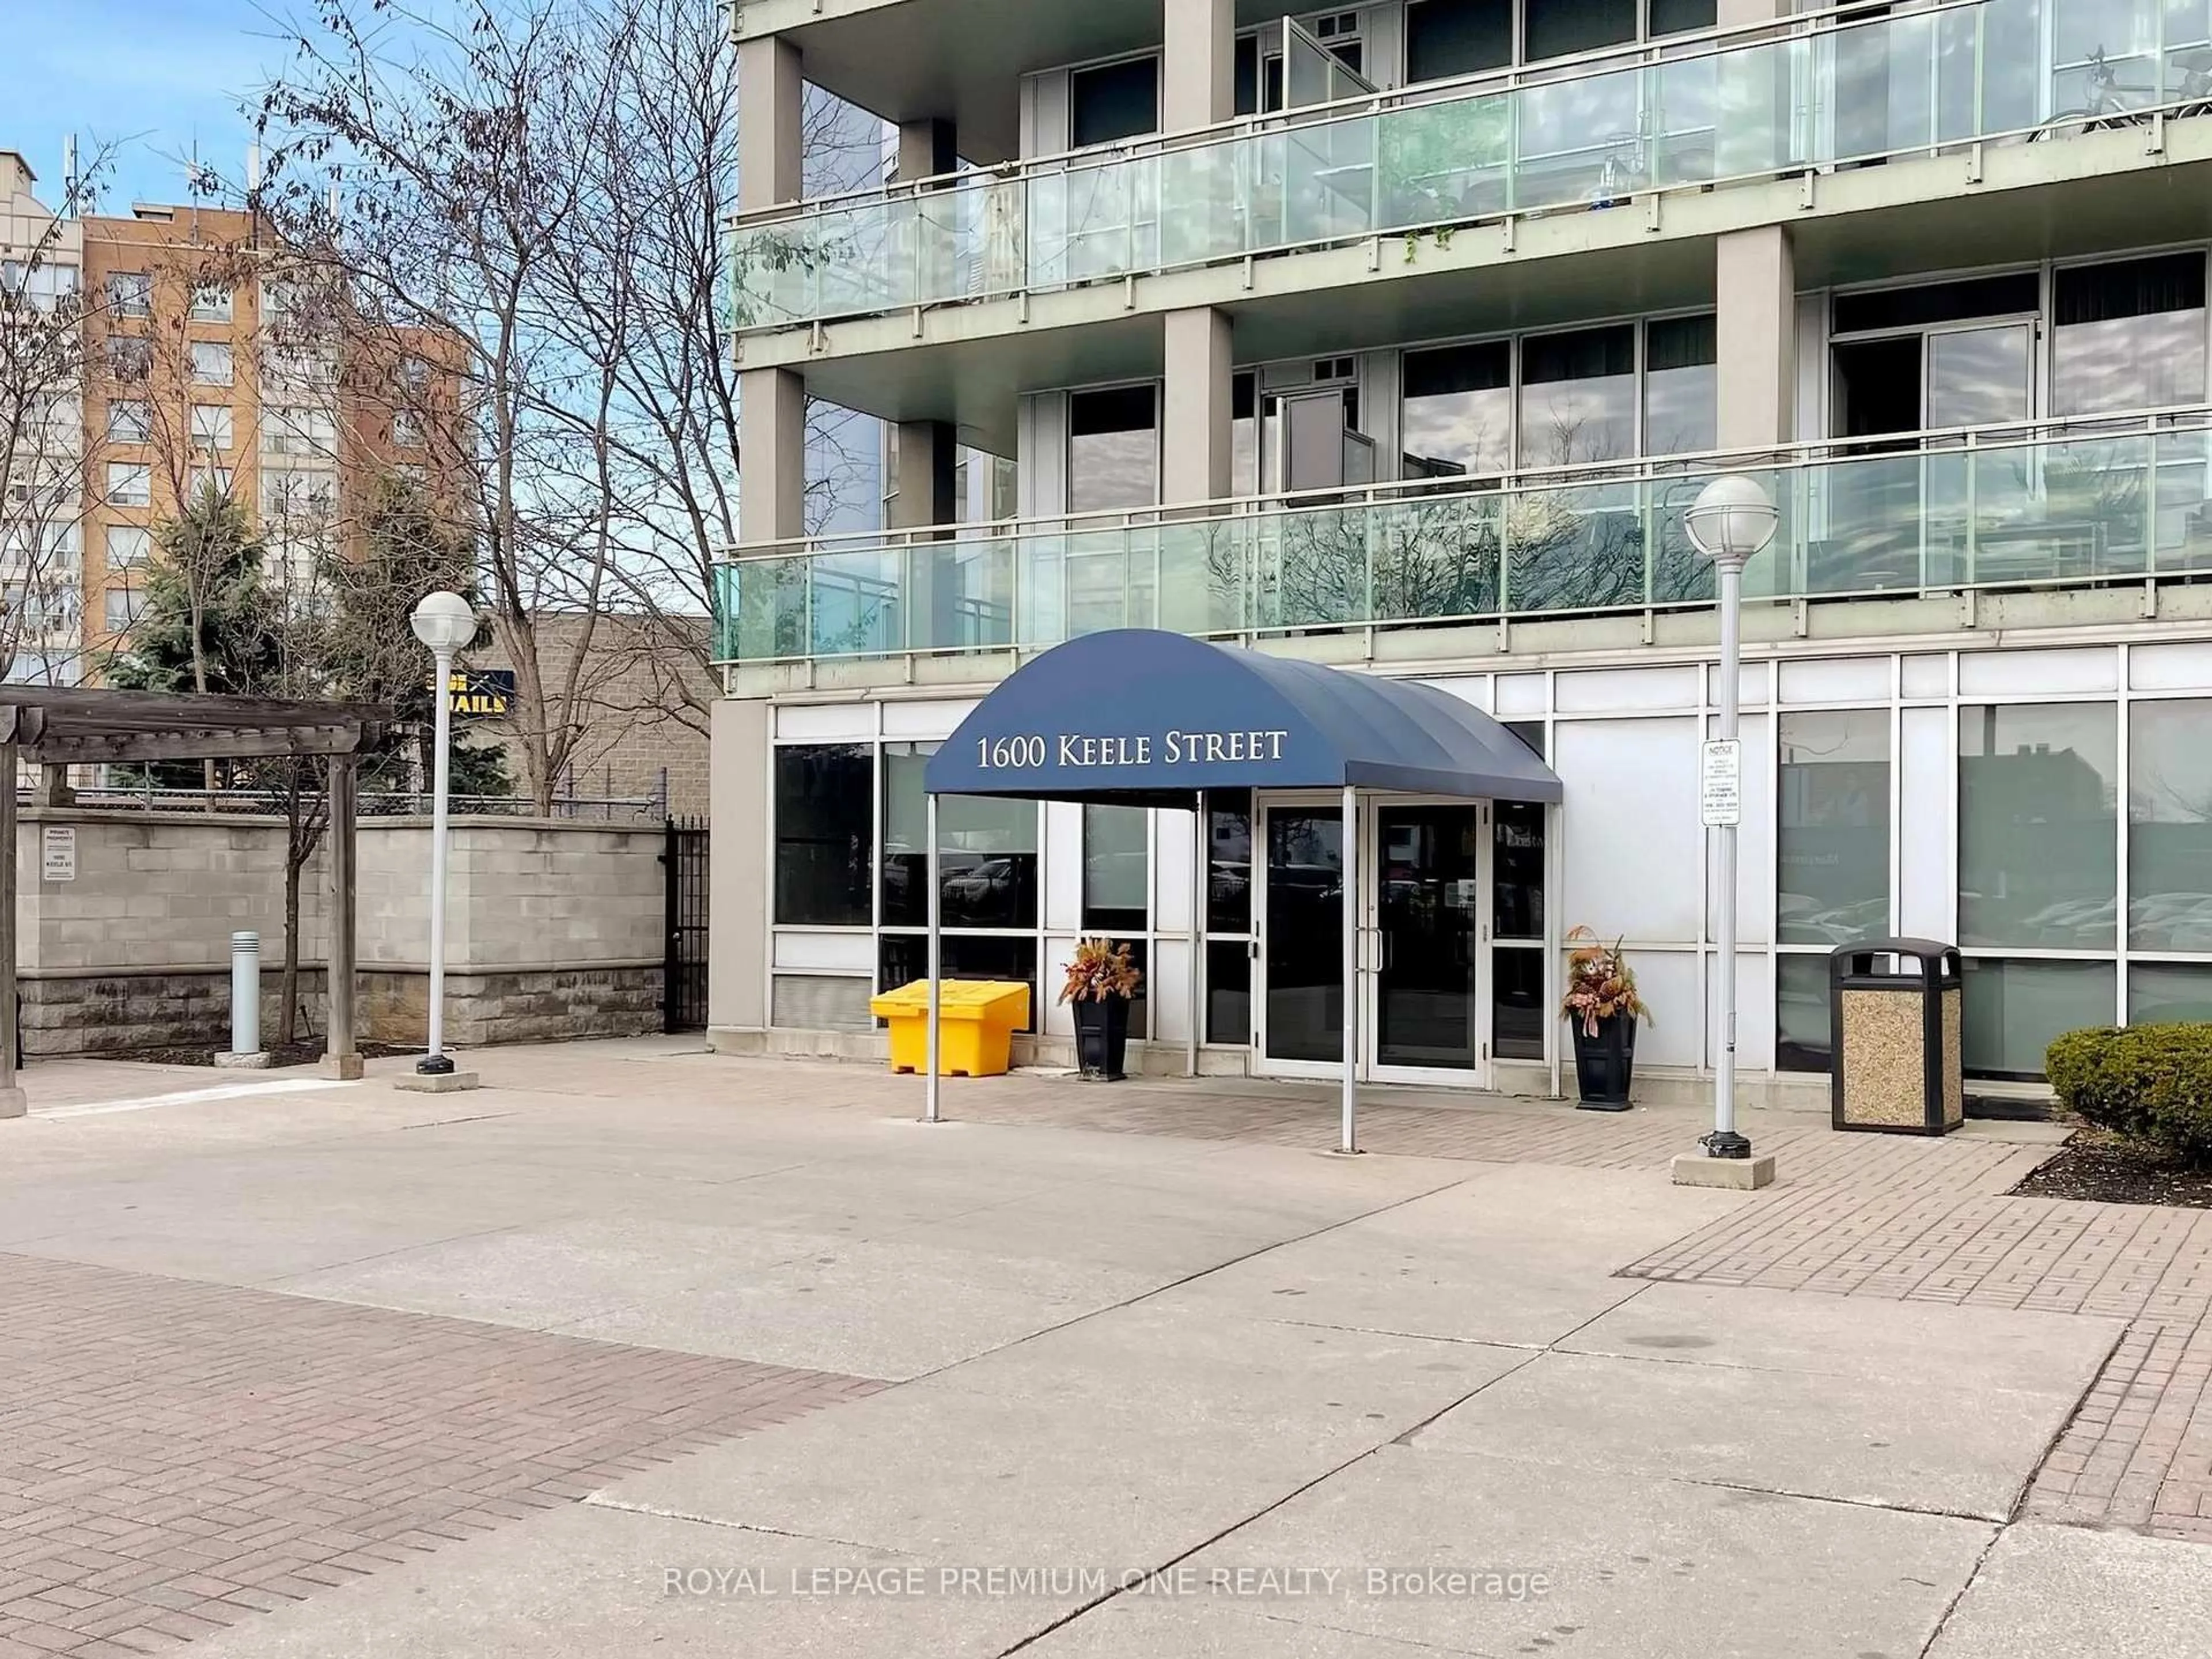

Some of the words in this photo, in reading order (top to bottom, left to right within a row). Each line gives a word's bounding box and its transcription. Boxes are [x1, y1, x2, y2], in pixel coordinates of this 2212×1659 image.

[977, 736, 1046, 768] 1600
[1058, 734, 1151, 767] KEELE
[1164, 730, 1288, 764] STREET
